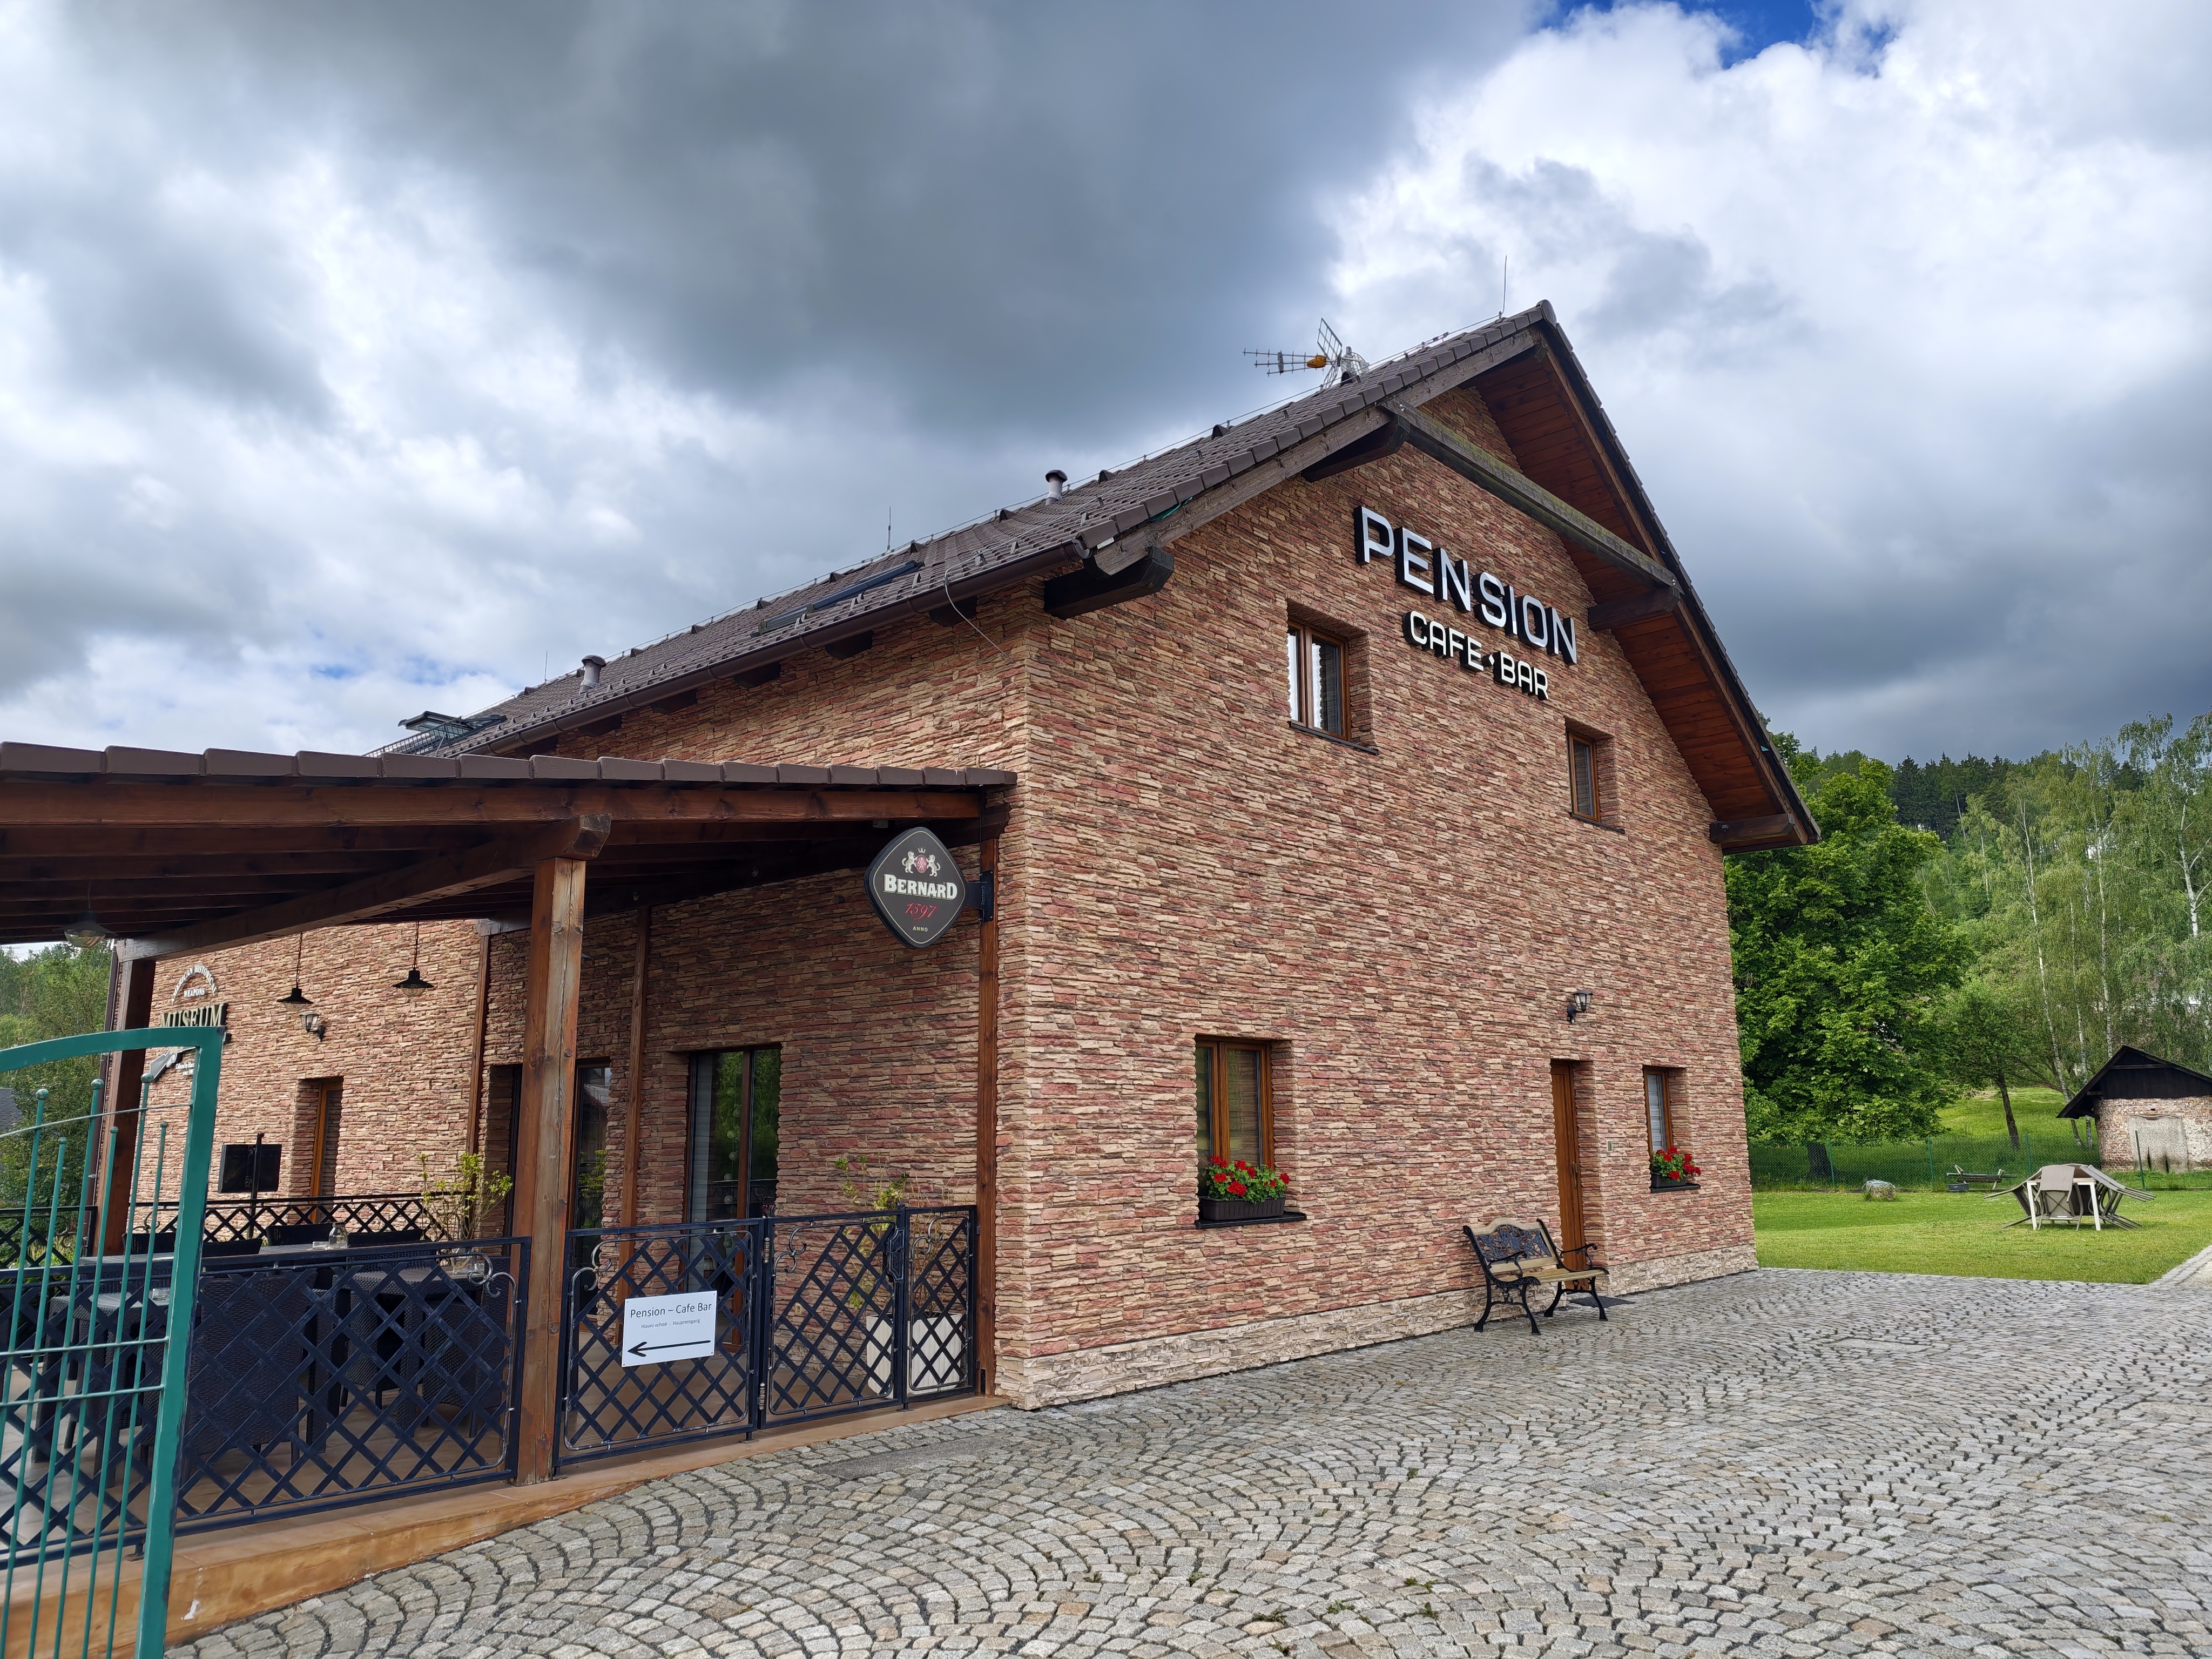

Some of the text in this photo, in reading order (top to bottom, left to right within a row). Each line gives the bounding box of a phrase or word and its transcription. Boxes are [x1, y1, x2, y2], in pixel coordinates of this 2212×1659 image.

[1354, 505, 1577, 665] PENSION
[1406, 610, 1549, 700] CAFE BAR
[884, 874, 957, 900] BERNARD
[905, 902, 938, 921] 1597
[184, 988, 205, 997] WEAPONS
[194, 965, 217, 996] HISTORICAL
[161, 1003, 225, 1027] MUSEUM
[630, 1307, 665, 1318] Pension
[676, 1303, 695, 1314] Cafe
[698, 1303, 712, 1311] Bar
